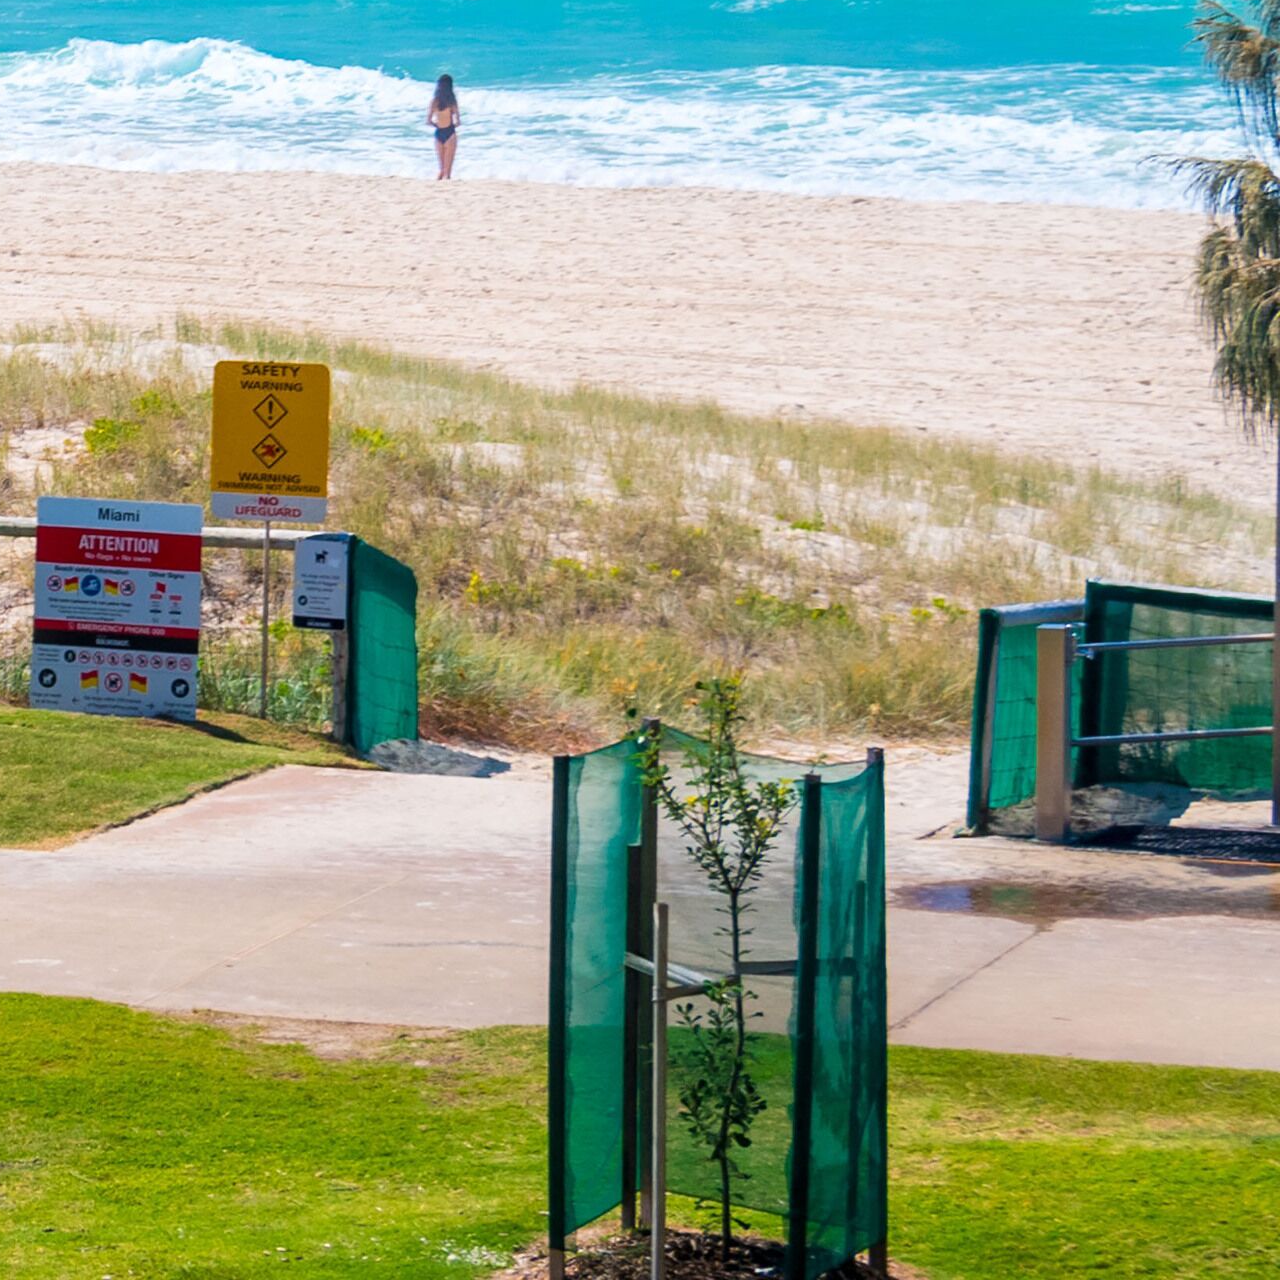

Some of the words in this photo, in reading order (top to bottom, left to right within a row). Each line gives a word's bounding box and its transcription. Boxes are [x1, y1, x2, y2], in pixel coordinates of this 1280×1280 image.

[242, 364, 301, 378] SAFETY
[240, 380, 303, 392] WARNING
[238, 472, 302, 483] WARNING
[258, 496, 279, 506] NO
[98, 507, 140, 522] Miami
[235, 506, 302, 518] LIFEGUARD
[78, 534, 160, 554] ATTENTION
